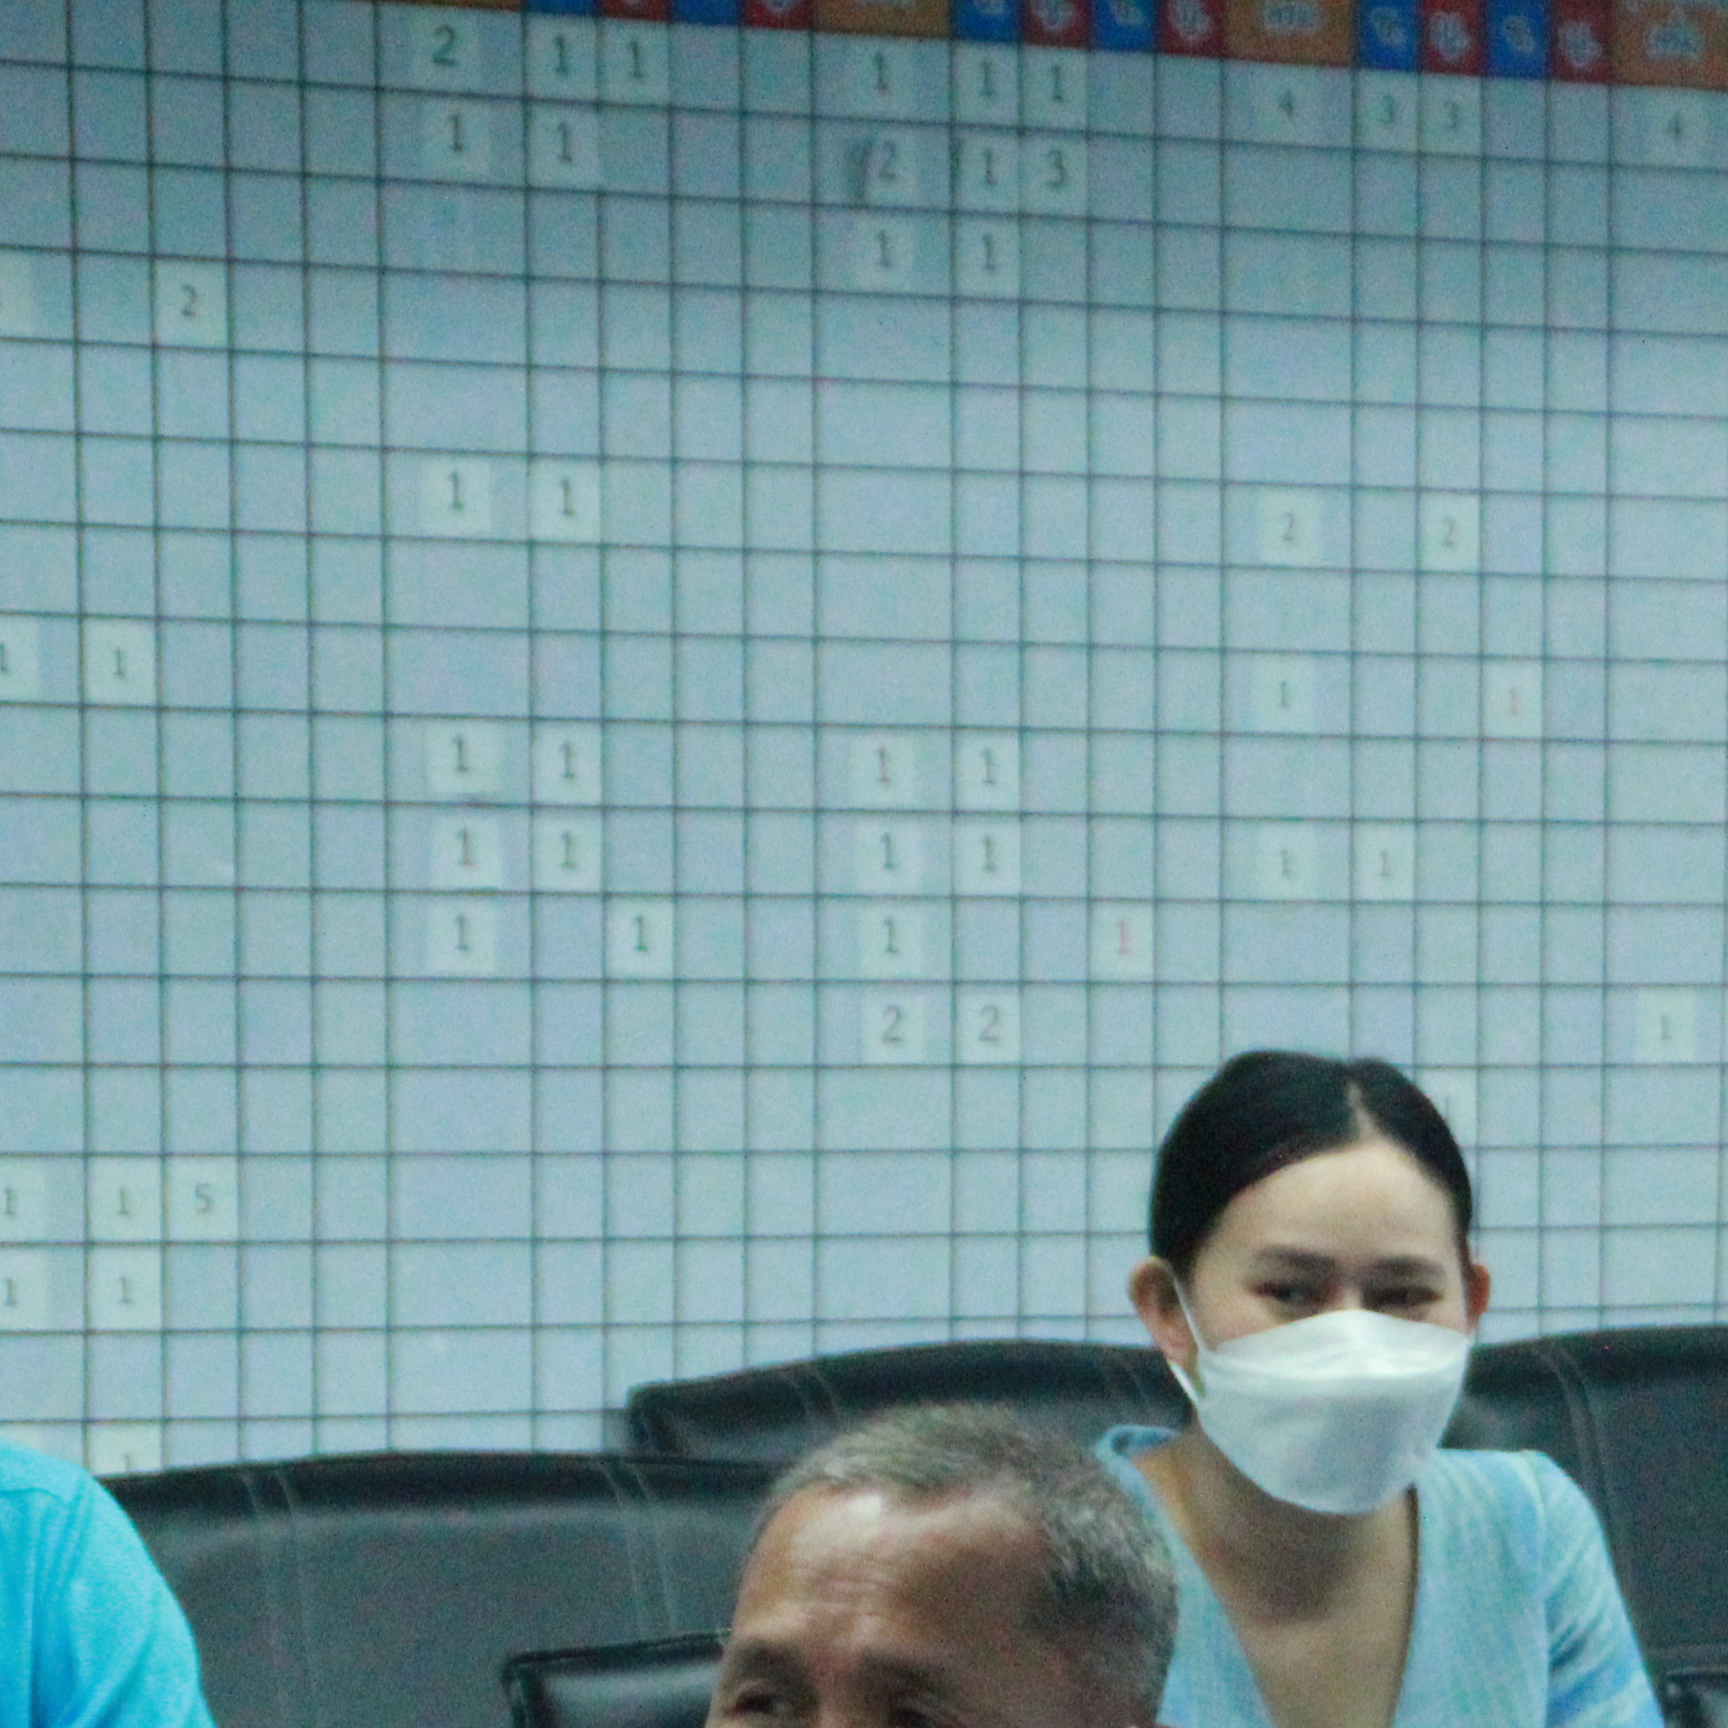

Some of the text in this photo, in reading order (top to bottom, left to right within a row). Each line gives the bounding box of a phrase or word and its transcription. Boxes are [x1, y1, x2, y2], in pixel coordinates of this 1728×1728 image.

[431, 21, 458, 69] 2
[552, 32, 570, 76] 1
[626, 36, 645, 81] 1
[872, 49, 891, 95] 1
[978, 58, 995, 98] 1
[1048, 63, 1066, 105] 1
[447, 108, 466, 155] 1
[555, 120, 575, 165] 1
[876, 138, 897, 181] 2
[981, 147, 998, 189] 1
[1046, 146, 1069, 191] 3
[875, 228, 893, 270] 1
[980, 231, 999, 275] 1
[180, 283, 201, 320] 2
[448, 469, 465, 513] 1
[557, 475, 577, 519] 1
[113, 647, 128, 681] 1
[452, 733, 472, 776] 1
[559, 739, 578, 783] 1
[875, 745, 893, 787] 1
[980, 747, 999, 789] 1
[456, 826, 475, 869] 1
[559, 829, 579, 872] 1
[880, 831, 899, 873] 1
[980, 833, 999, 875] 1
[454, 912, 472, 954] 1
[633, 913, 651, 955] 1
[882, 915, 901, 957] 1
[1115, 917, 1132, 957] 1
[881, 1002, 906, 1047] 2
[978, 1002, 1002, 1046] 2
[1, 1185, 18, 1220] 1
[117, 1186, 134, 1219] 1
[193, 1181, 215, 1216] 5
[3, 1274, 135, 1310] 1 1
